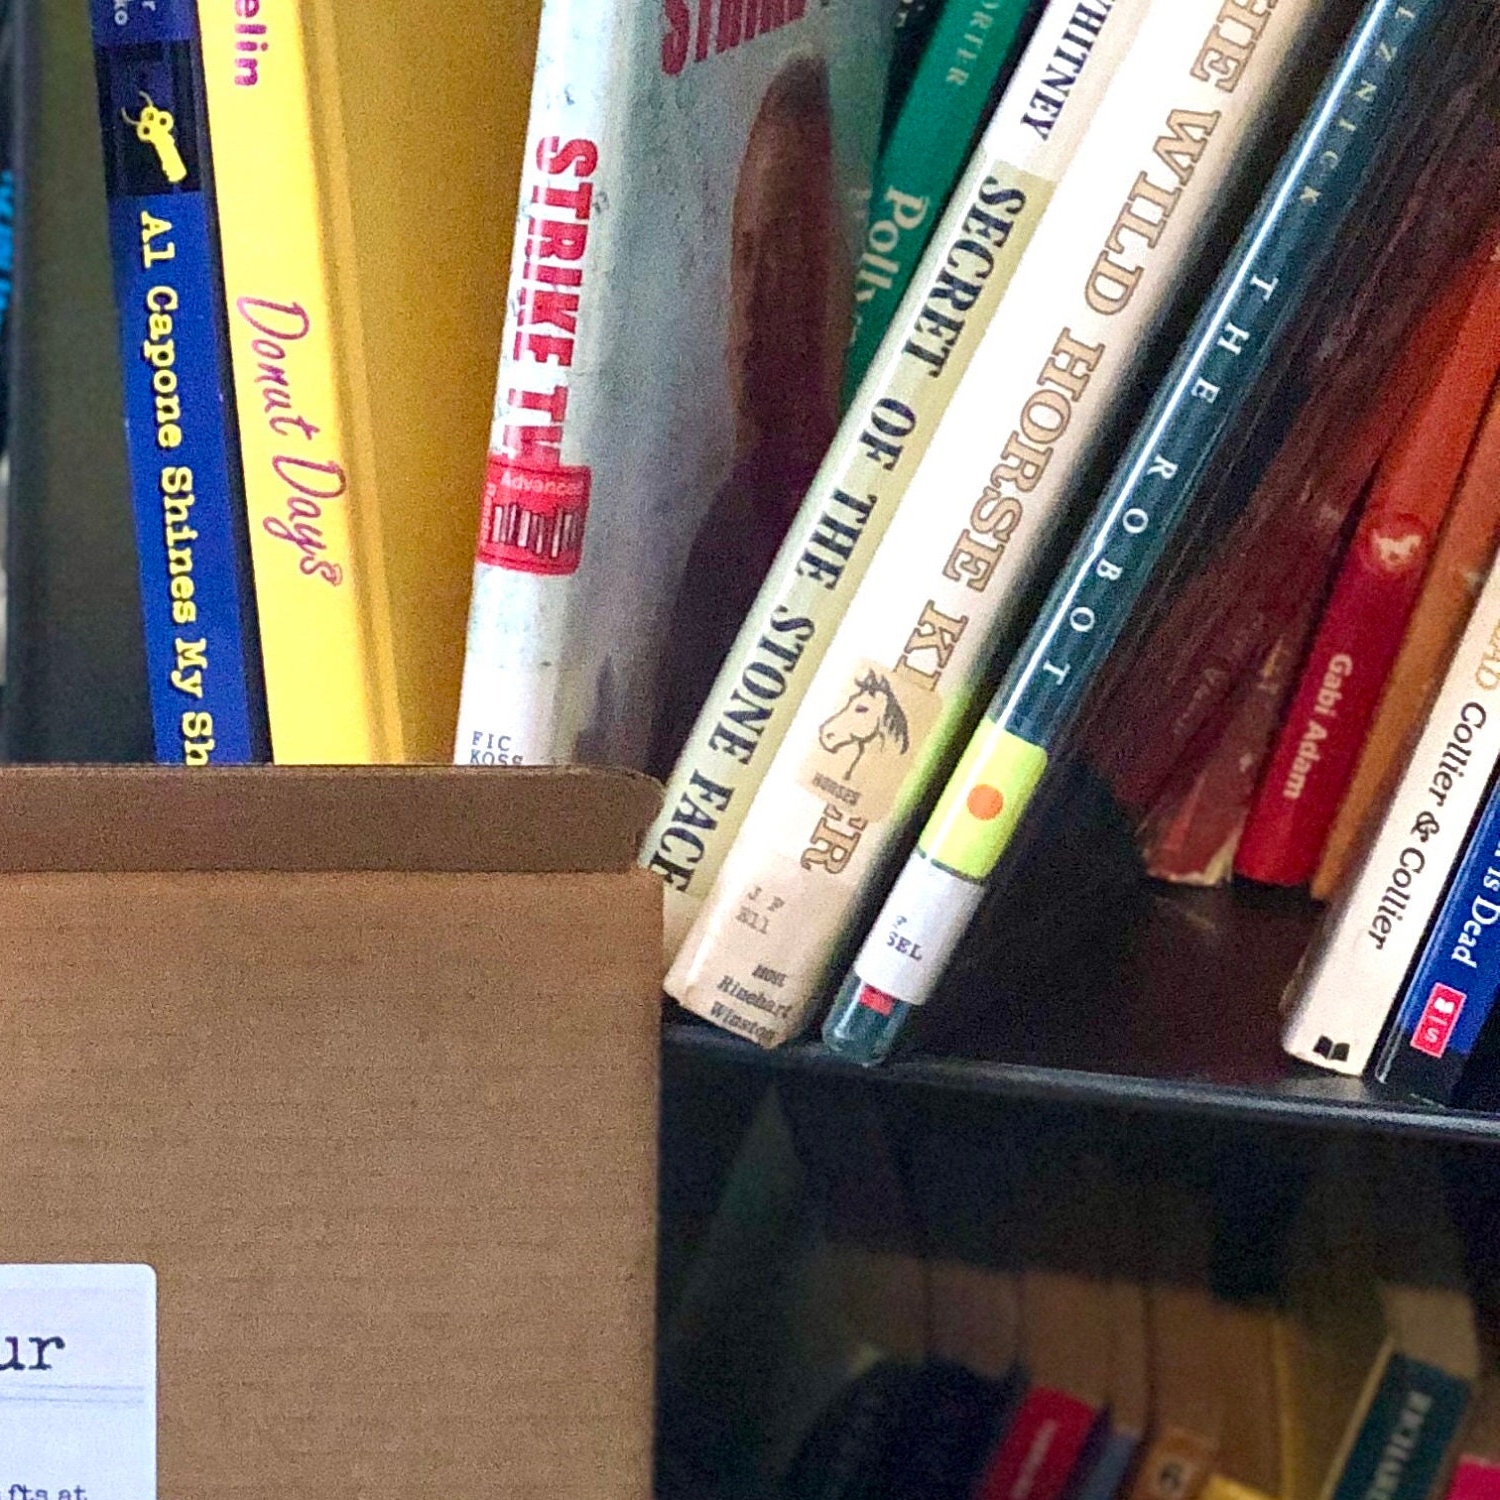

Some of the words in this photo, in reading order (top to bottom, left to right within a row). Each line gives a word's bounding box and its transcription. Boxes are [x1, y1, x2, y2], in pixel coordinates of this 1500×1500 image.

[234, 0, 269, 86] elin
[1189, 0, 1280, 93] HE
[1297, 2, 1416, 206] LZNICK
[140, 210, 174, 268] Al
[514, 135, 599, 367] STRIKE
[1084, 107, 1219, 317] WILD
[902, 177, 1026, 380] SECRET
[143, 288, 184, 449] Capone
[235, 295, 311, 441] Donut
[1189, 273, 1281, 405] THE
[867, 398, 917, 472] OF
[942, 327, 1106, 592] HORSE
[159, 466, 196, 624] Shines
[262, 453, 347, 589] Days
[795, 489, 871, 590] THE
[1041, 453, 1179, 687] ROBOT
[170, 640, 207, 699] My
[709, 605, 816, 767] STONE
[1311, 653, 1353, 717] Gabi
[181, 711, 216, 765] Sh
[472, 730, 512, 752] FIC
[1283, 724, 1328, 803] Adam
[1429, 702, 1487, 808] Collier
[651, 769, 735, 893] FACE
[1410, 810, 1440, 843] &
[886, 931, 923, 962] SEL
[1368, 847, 1425, 950] Collier
[1451, 895, 1500, 968] Dead
